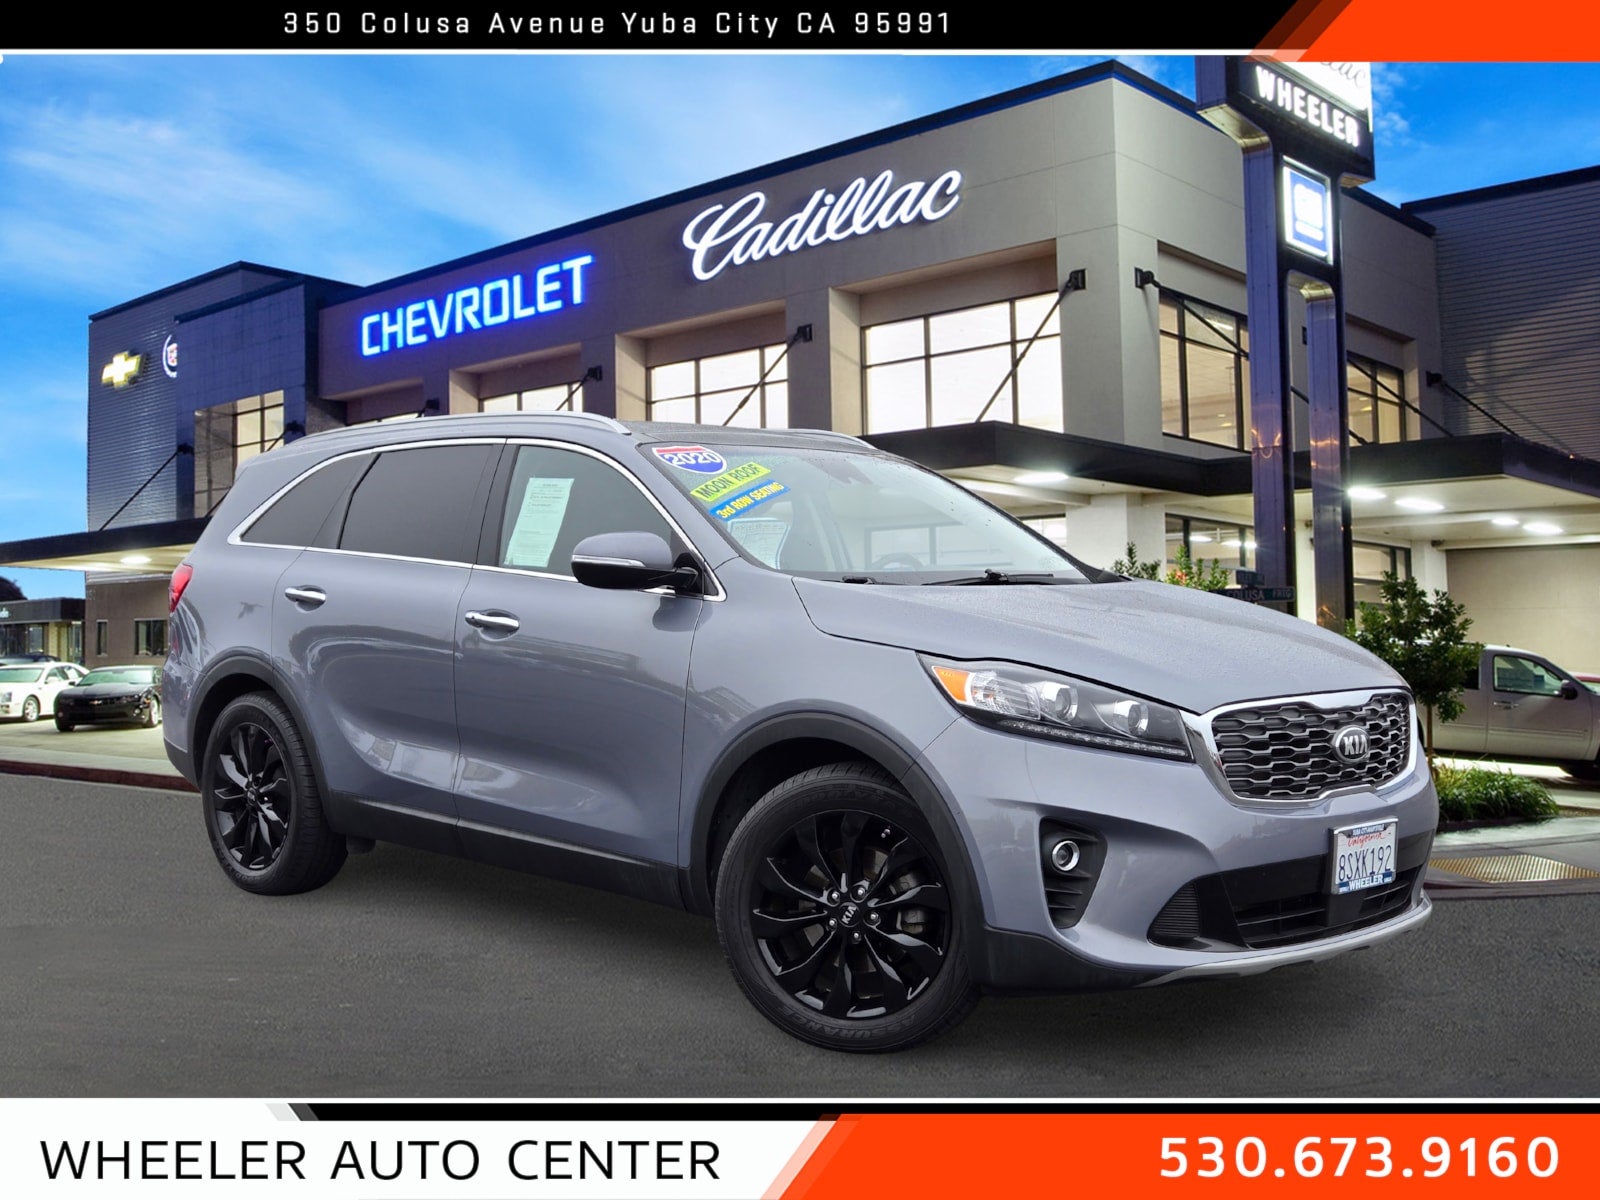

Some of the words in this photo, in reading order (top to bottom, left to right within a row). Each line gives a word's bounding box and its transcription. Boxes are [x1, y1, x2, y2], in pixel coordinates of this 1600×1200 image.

[1255, 64, 1360, 148] WHEELER
[681, 168, 964, 282] Cadillac
[360, 254, 594, 357] CHEVROLET
[664, 451, 722, 466] 2020
[695, 477, 733, 498] MOON
[731, 462, 761, 482] ROOF
[716, 503, 736, 518] 3rd
[734, 493, 754, 509] ROW
[1343, 734, 1368, 756] KIA
[1338, 844, 1392, 882] 8SXK192
[1349, 874, 1384, 891] WHEELER
[841, 905, 857, 924] KIA
